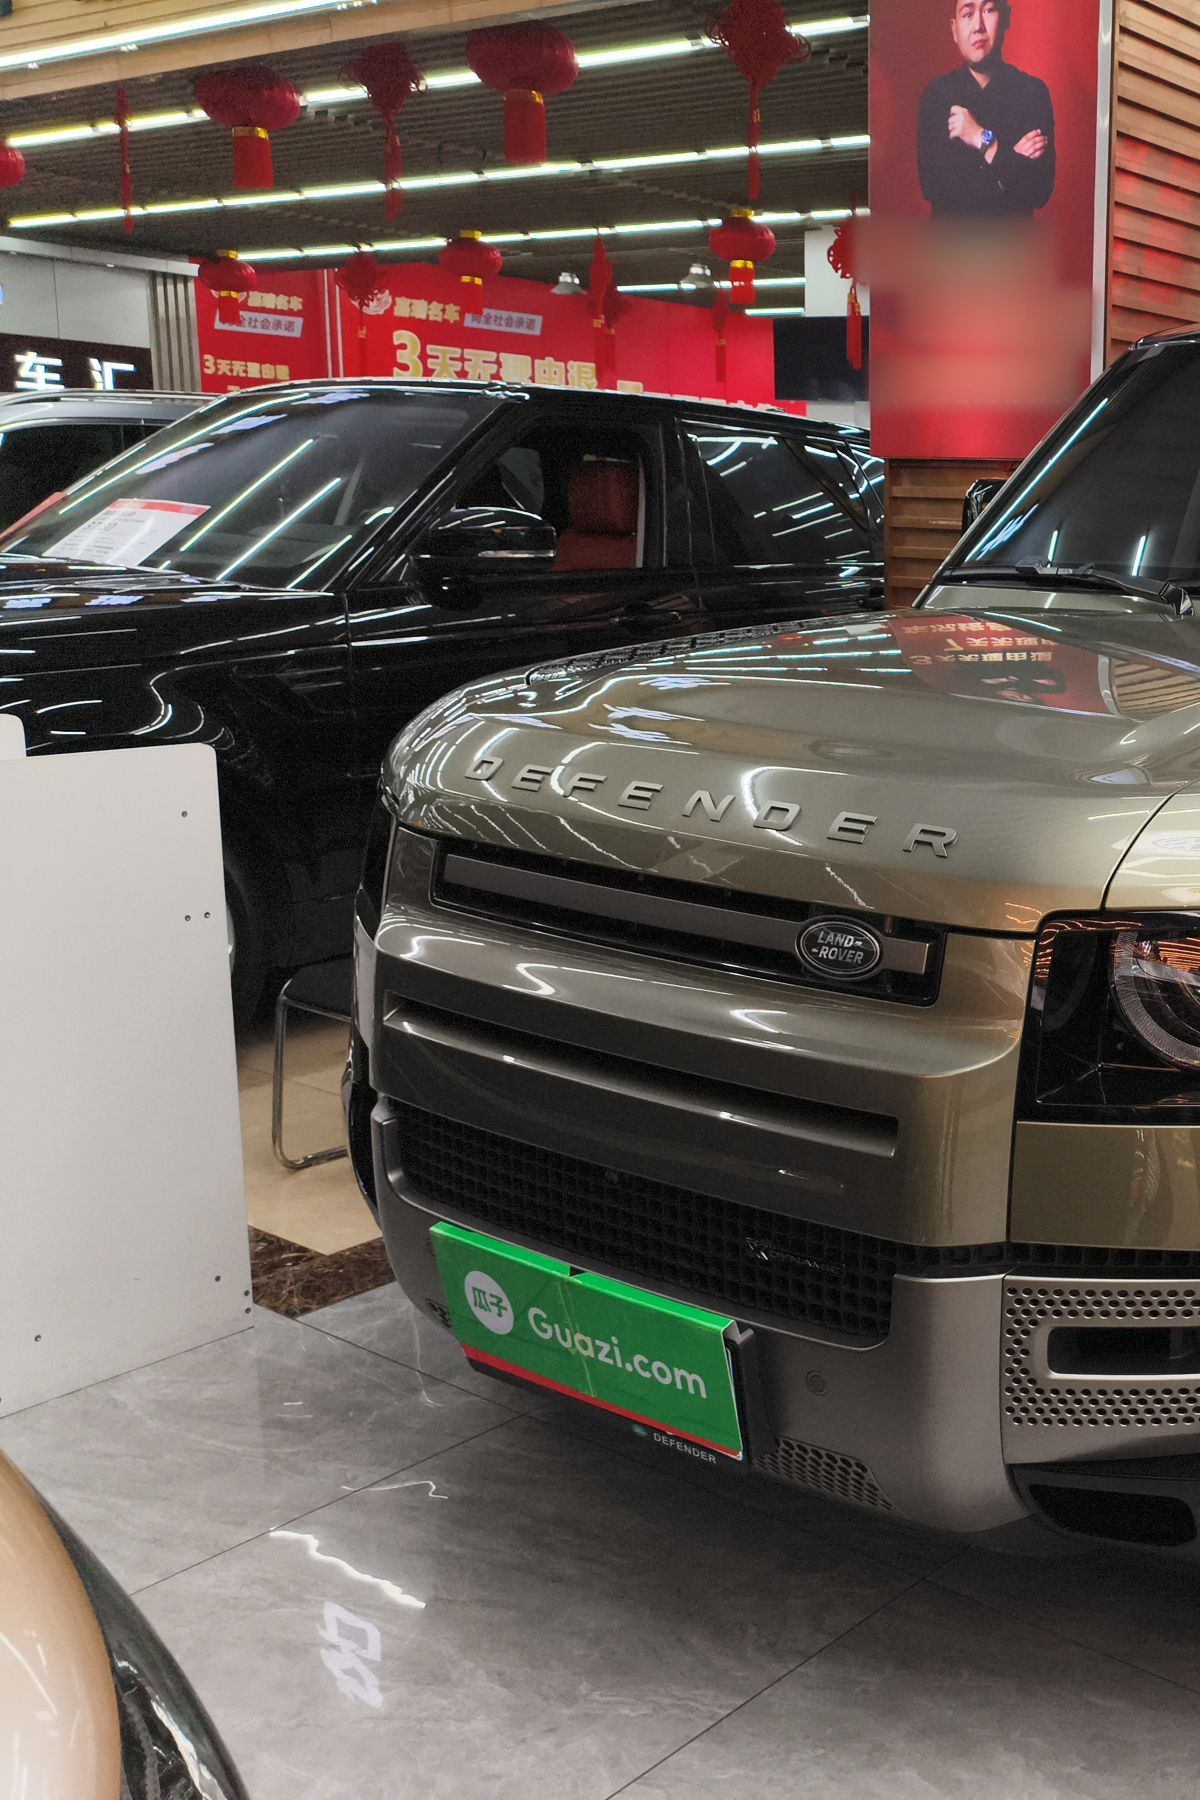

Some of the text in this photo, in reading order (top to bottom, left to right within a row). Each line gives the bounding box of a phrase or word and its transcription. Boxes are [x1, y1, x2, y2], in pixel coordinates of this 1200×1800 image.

[464, 755, 959, 859] DEFENDER
[471, 1286, 508, 1319] 瓜子
[527, 1306, 708, 1400] Guazi.com
[653, 1432, 717, 1464] DEFENDER
